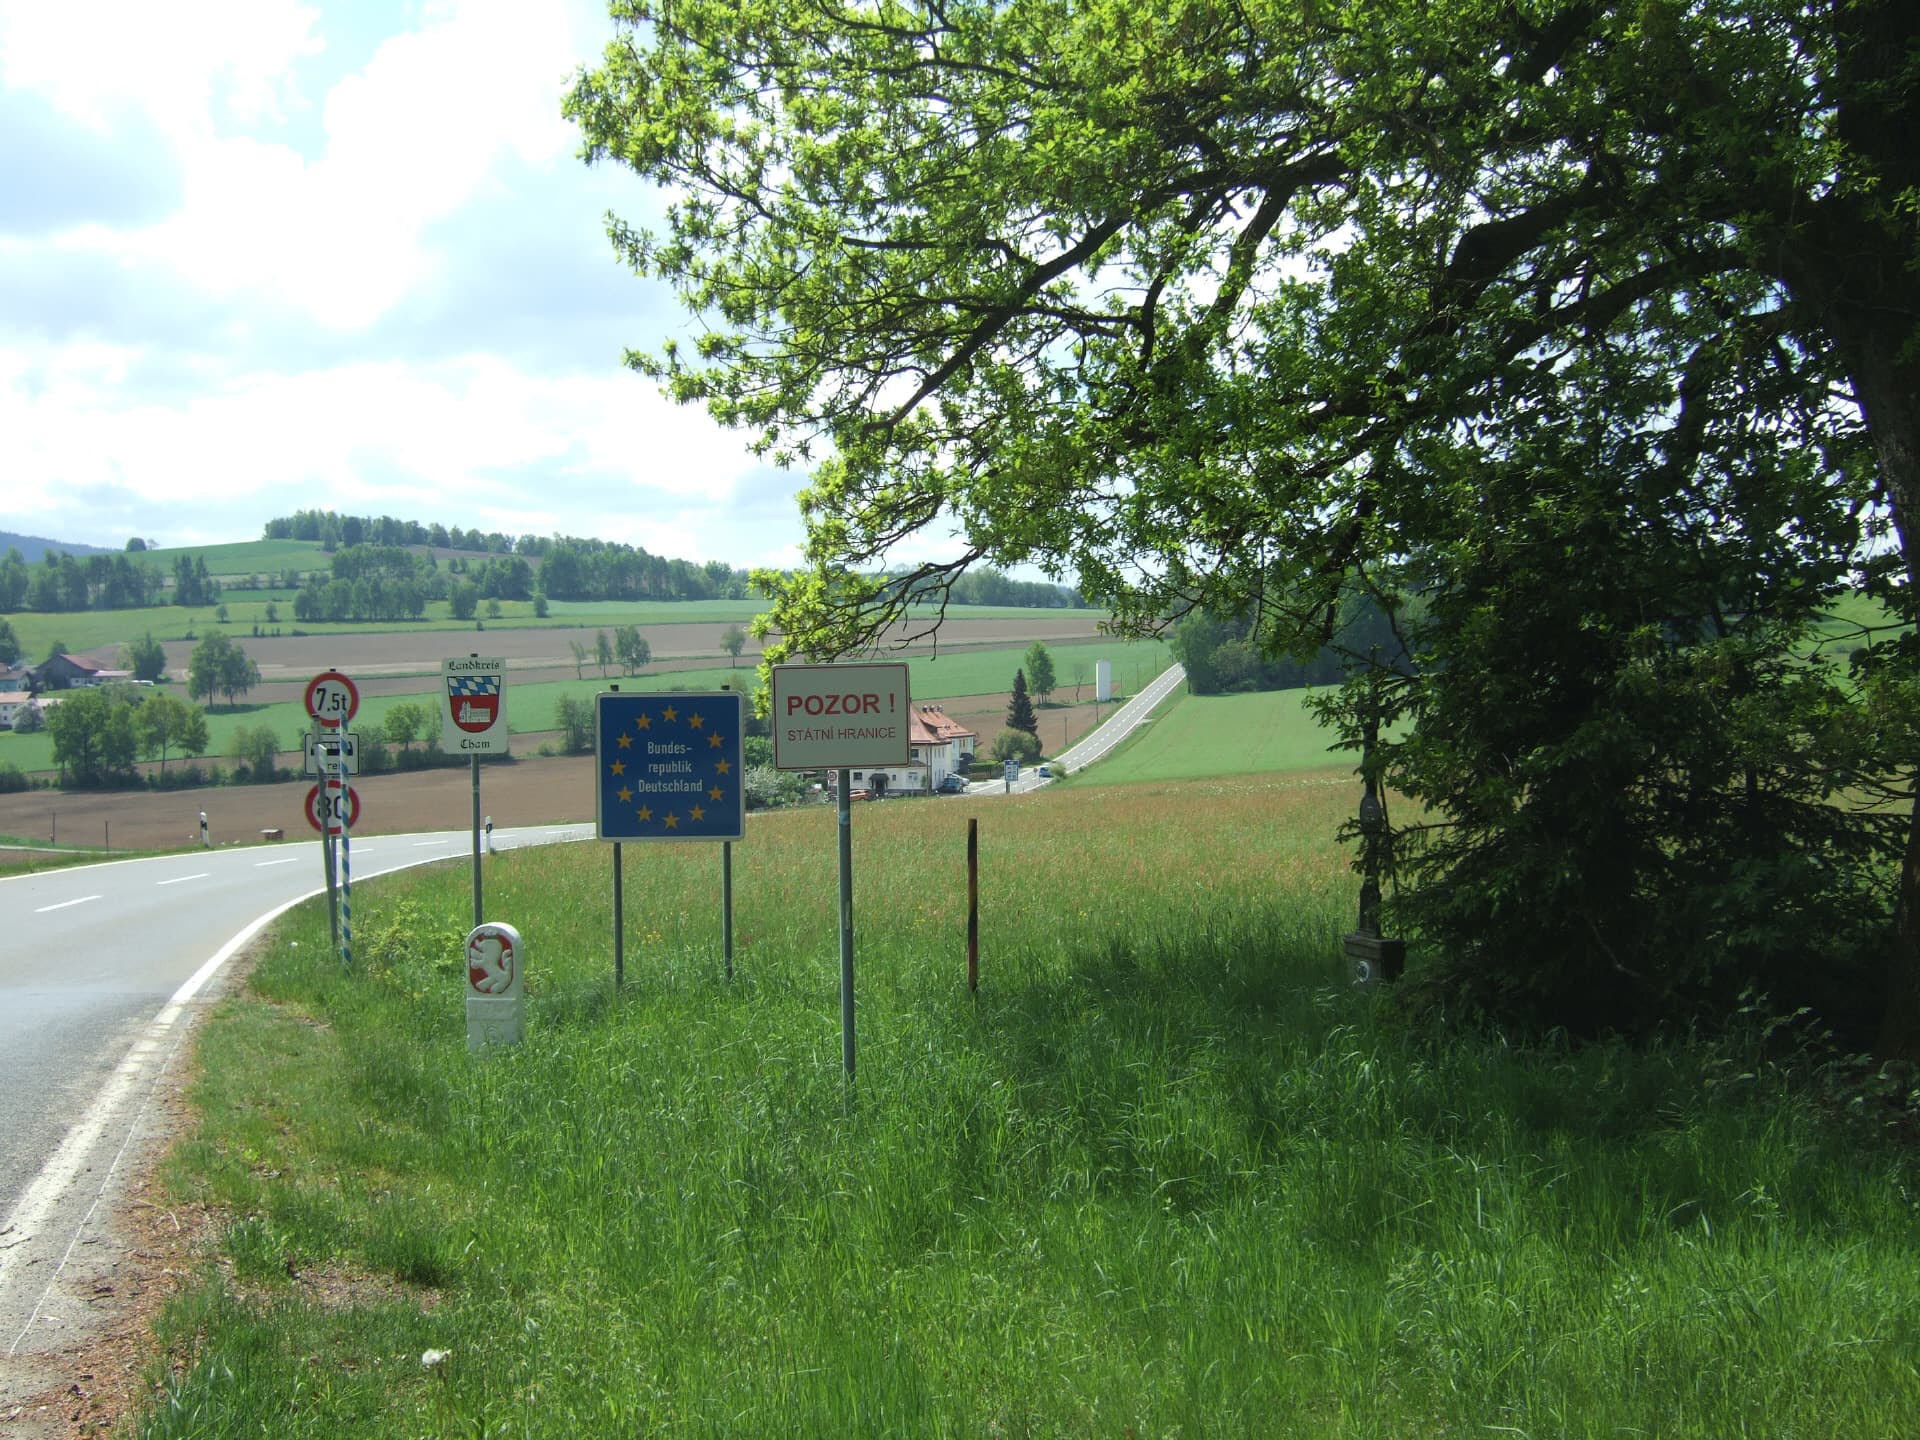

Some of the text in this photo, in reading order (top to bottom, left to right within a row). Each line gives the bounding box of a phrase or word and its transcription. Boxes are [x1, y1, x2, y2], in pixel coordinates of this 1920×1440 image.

[448, 660, 500, 671] Landkreis
[787, 725, 896, 741] STÁTNÍ HRANICE
[460, 739, 490, 749] Cham
[647, 740, 693, 754] Bundes-
[648, 760, 692, 776] republik
[638, 779, 703, 792] Deutschland
